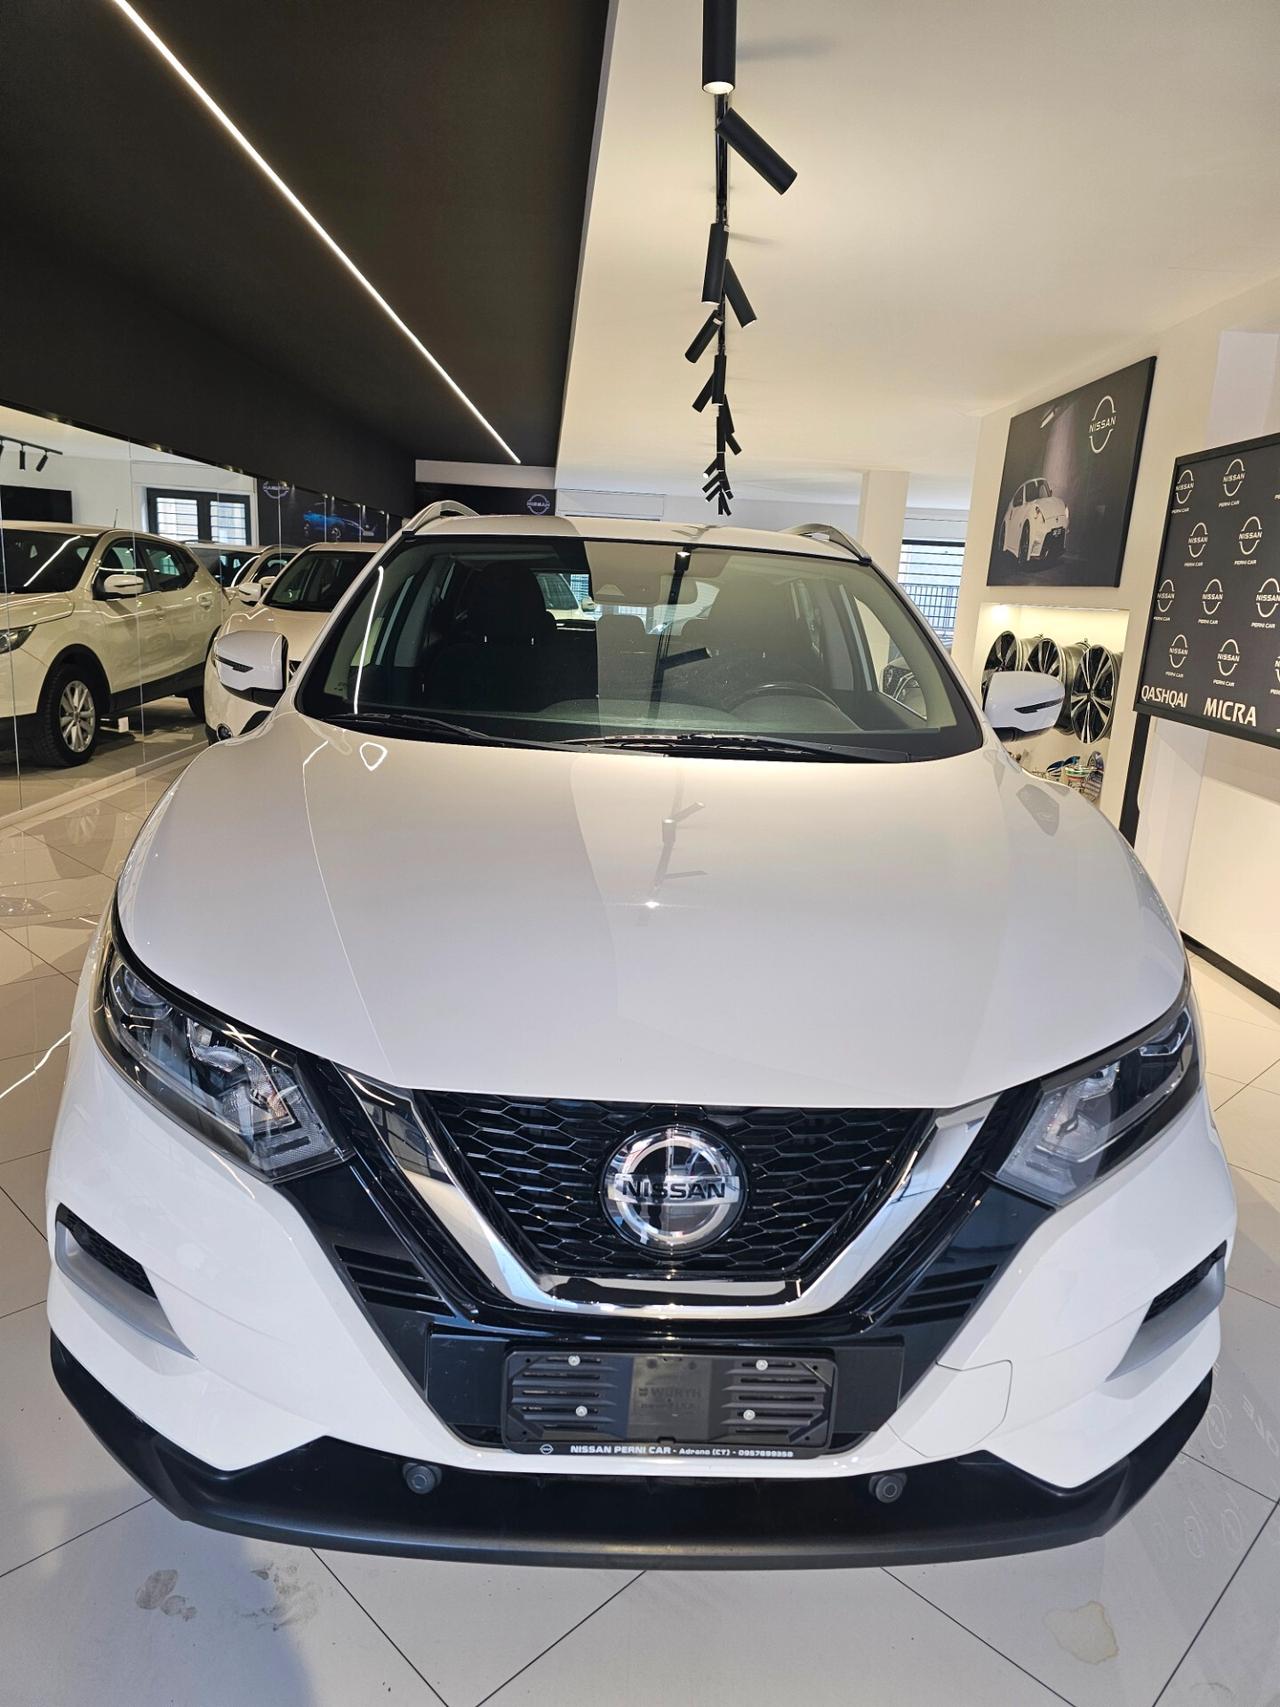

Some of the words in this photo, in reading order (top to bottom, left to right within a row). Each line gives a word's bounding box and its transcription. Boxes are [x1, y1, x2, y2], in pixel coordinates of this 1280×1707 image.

[1089, 416, 1117, 433] NISSAN
[1222, 472, 1246, 483] NISSAN
[1175, 482, 1194, 491] NISSAN
[1188, 536, 1208, 544] NISSAN
[1239, 531, 1263, 540] NISSAN
[1157, 592, 1175, 600] NISSAN
[1202, 593, 1223, 601] NISSAN
[1256, 594, 1280, 602] NISSAN
[1169, 647, 1188, 656] NISSAN
[1217, 653, 1240, 662] NISSAN
[1141, 685, 1188, 709] QASHQAI
[1203, 697, 1257, 727] MICRA
[622, 1179, 726, 1199] NISSAN
[570, 1445, 612, 1454] NISSAN
[614, 1446, 646, 1454] PERNI
[648, 1446, 671, 1454] CAR
[712, 1448, 730, 1456] (CT)
